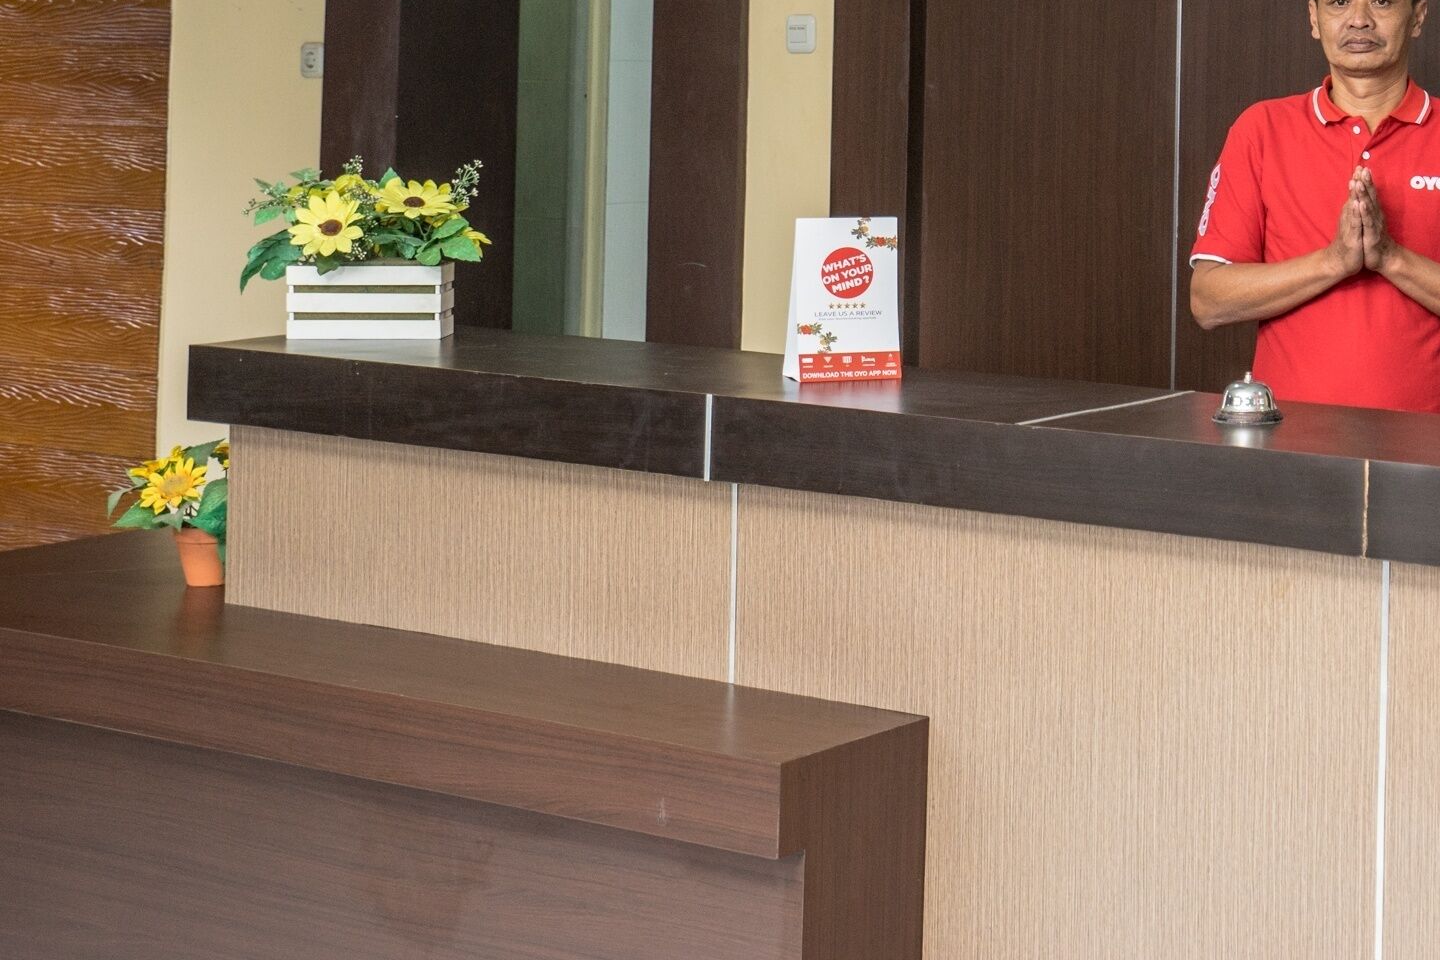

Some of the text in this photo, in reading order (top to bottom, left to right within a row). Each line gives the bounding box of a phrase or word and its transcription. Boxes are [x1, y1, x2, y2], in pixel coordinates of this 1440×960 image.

[822, 253, 867, 273] WHAT'S
[822, 263, 872, 285] ON YOUR
[802, 370, 840, 379] DOWNLOAD
